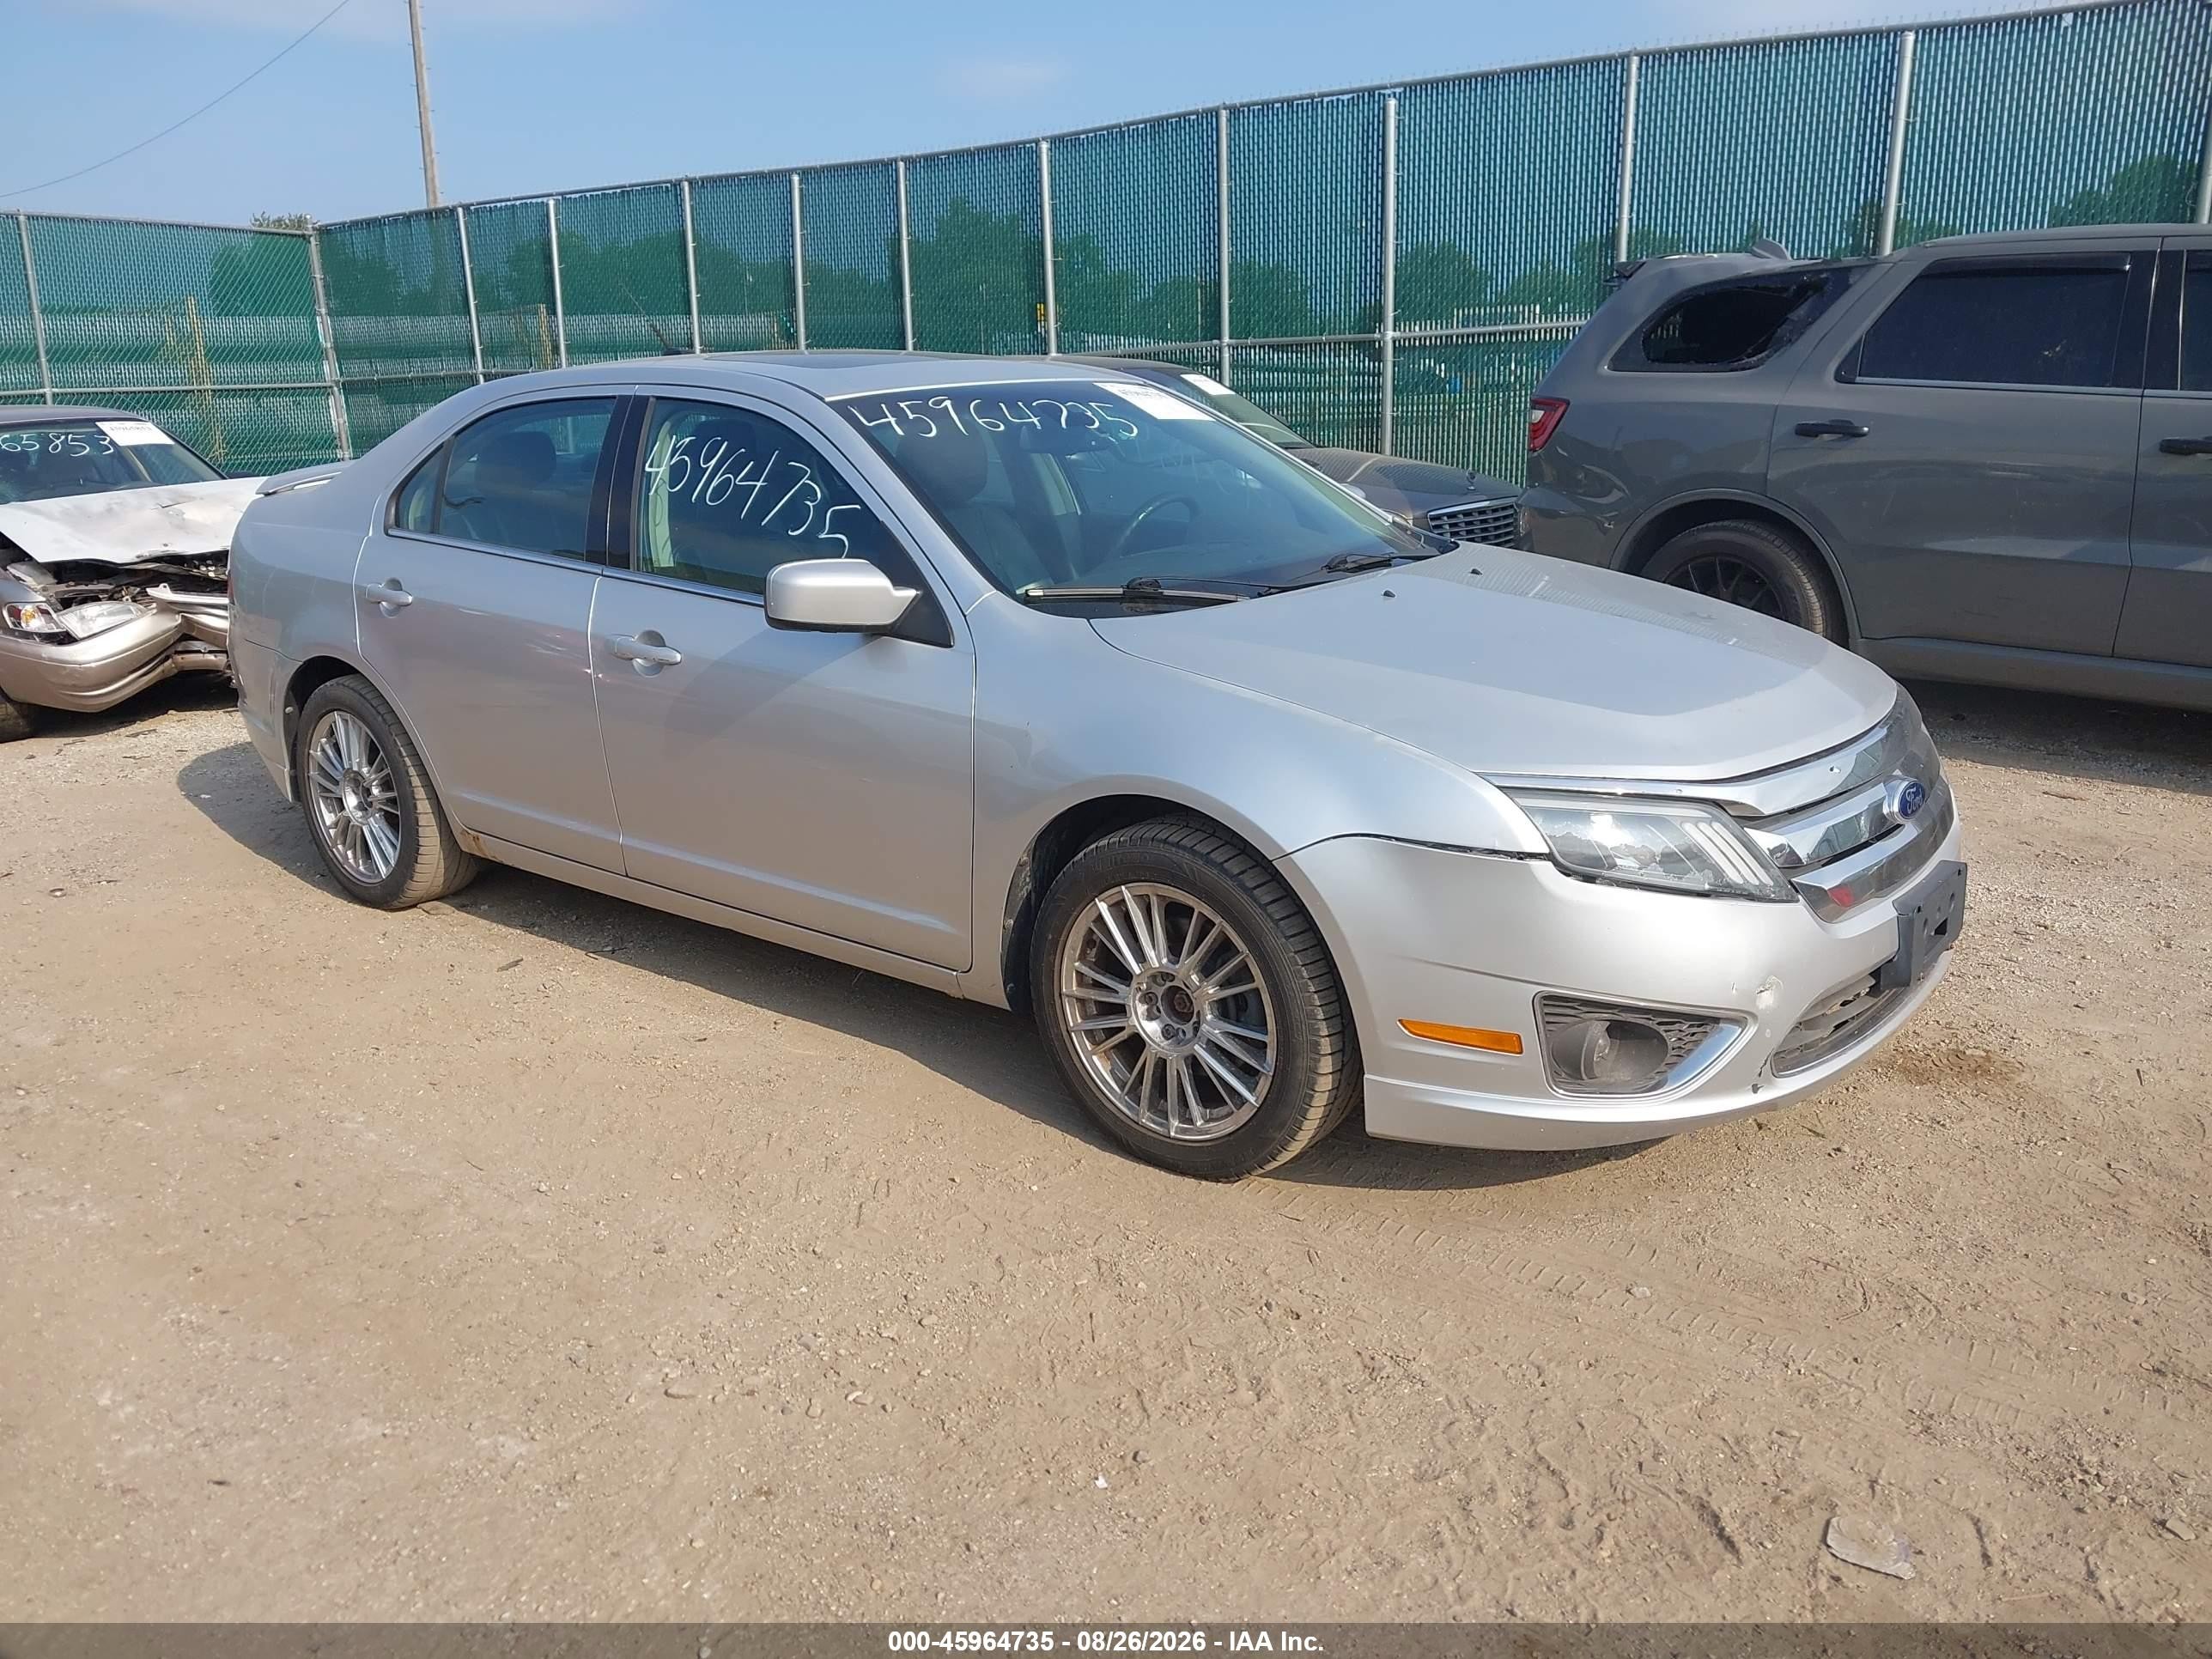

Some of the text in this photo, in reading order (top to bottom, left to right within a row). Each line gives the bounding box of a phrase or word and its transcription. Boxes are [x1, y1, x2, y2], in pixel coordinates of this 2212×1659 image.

[848, 396, 1139, 438] 45964735
[645, 434, 861, 558] 45964735
[1906, 786, 1924, 814] Ford
